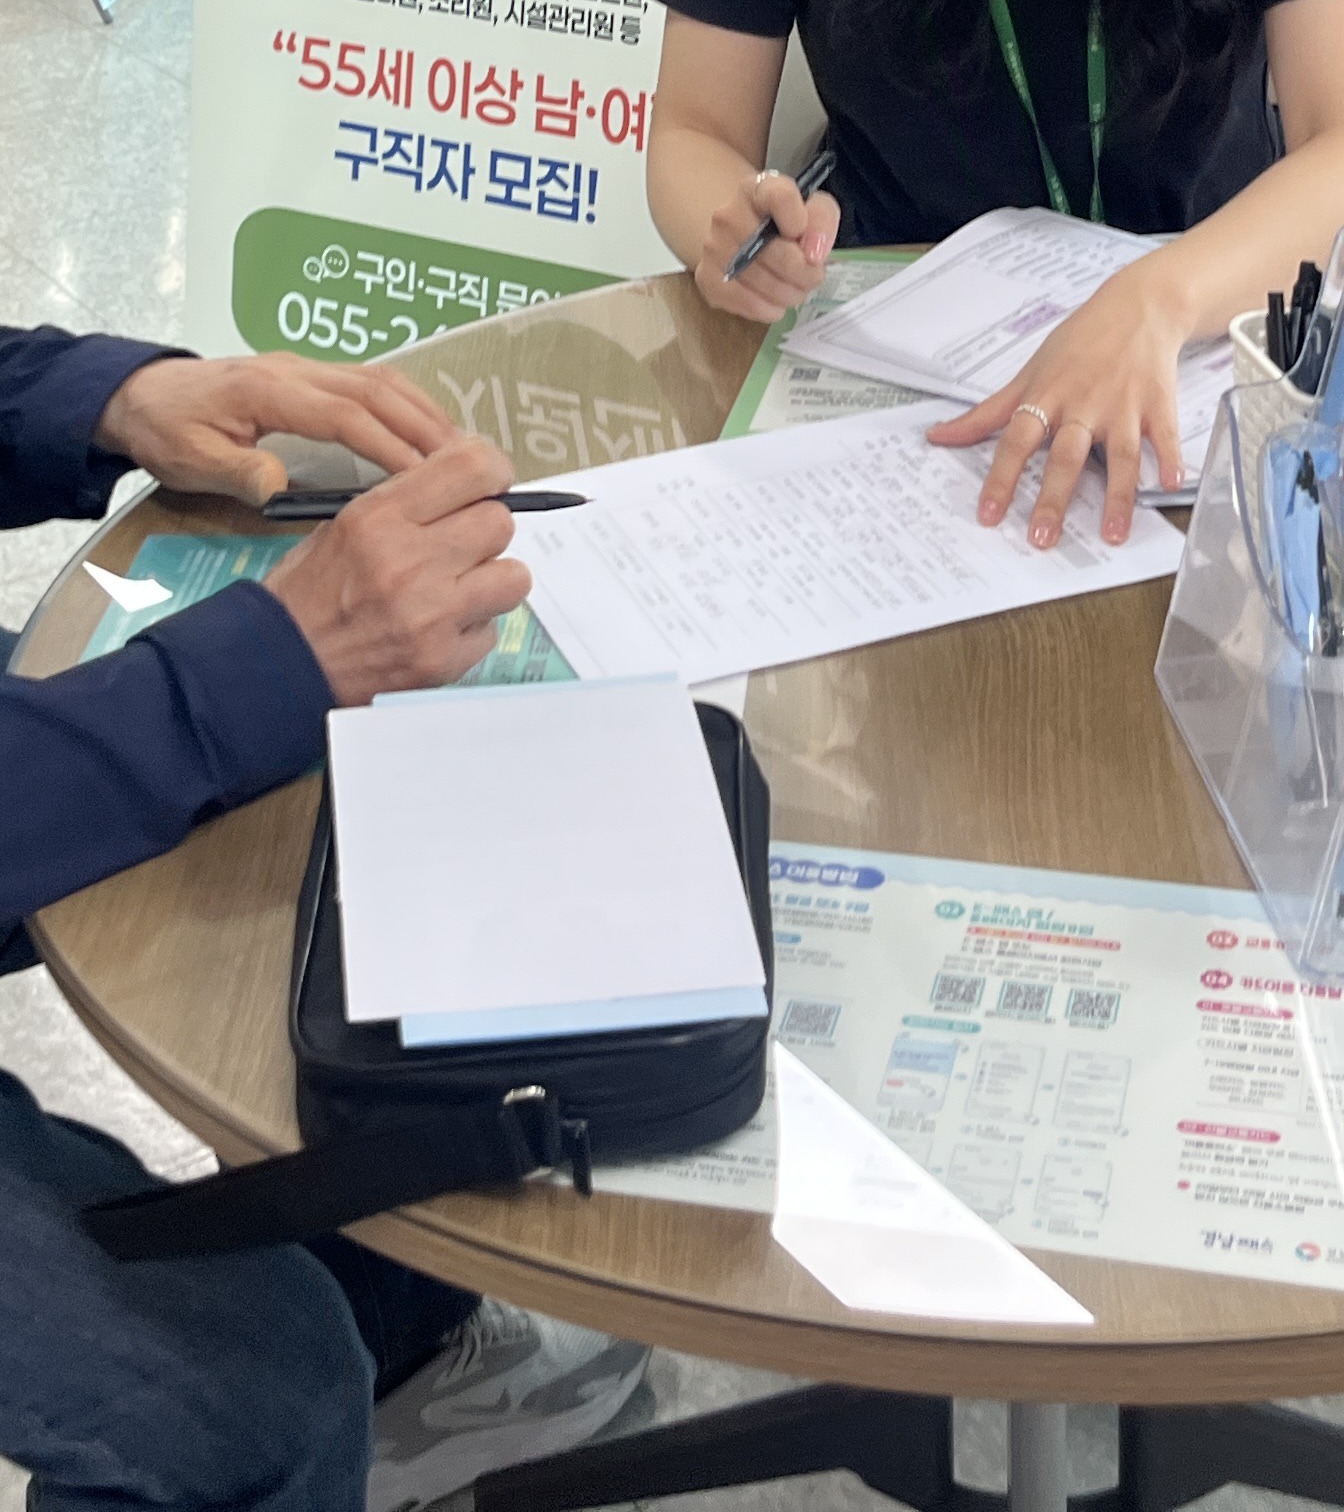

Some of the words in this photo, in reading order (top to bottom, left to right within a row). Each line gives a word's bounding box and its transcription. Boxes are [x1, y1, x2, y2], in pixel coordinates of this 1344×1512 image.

[619, 14, 643, 46] 등
[426, 56, 524, 126] 이상
[334, 119, 476, 202] 구직자
[483, 148, 599, 225] 모집!
[353, 249, 489, 318] 구인·구직
[277, 291, 447, 356] 055-2
